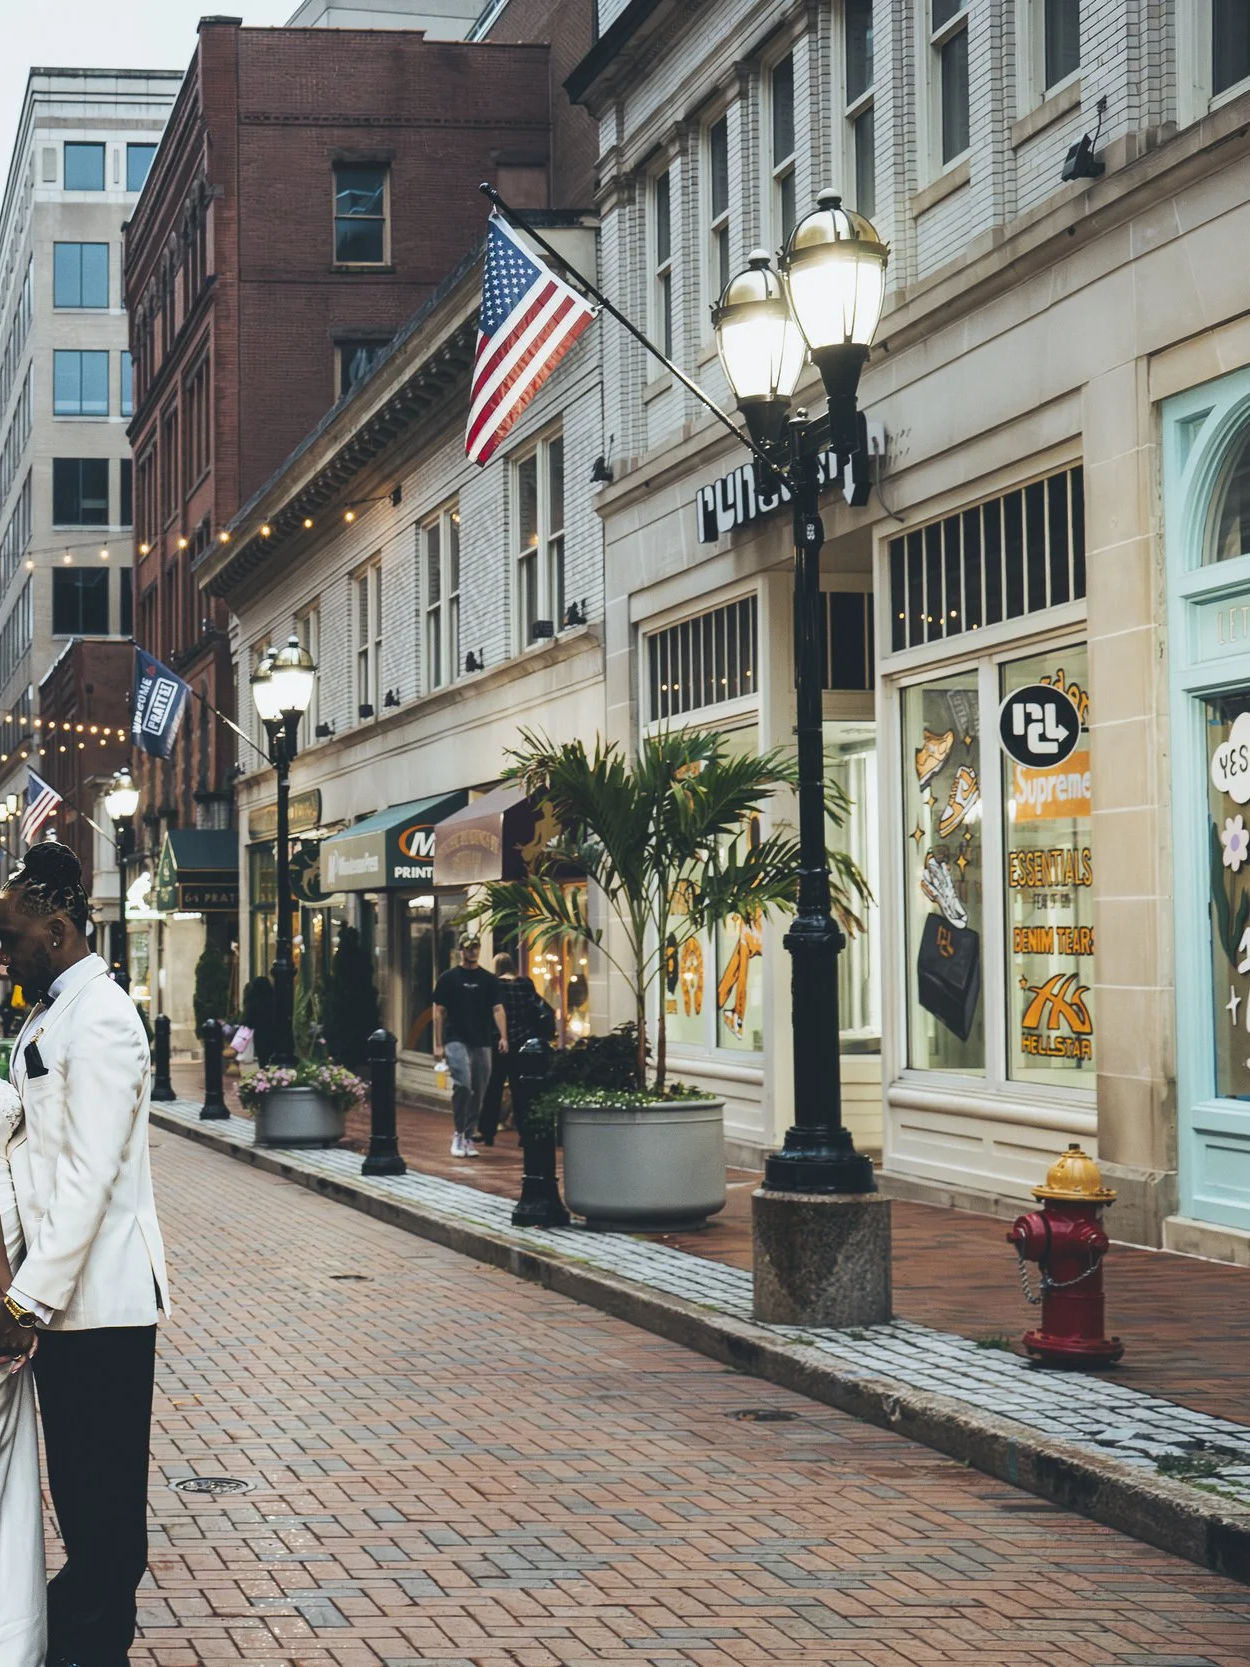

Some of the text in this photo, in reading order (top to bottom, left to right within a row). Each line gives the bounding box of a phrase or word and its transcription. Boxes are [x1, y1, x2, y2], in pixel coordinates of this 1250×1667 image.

[1219, 744, 1249, 779] YES
[1014, 766, 1091, 815] Supreme
[1008, 847, 1093, 888] ESSENTIALS
[1013, 926, 1055, 955] DENIM
[1021, 1032, 1092, 1061] HELLSTAR
